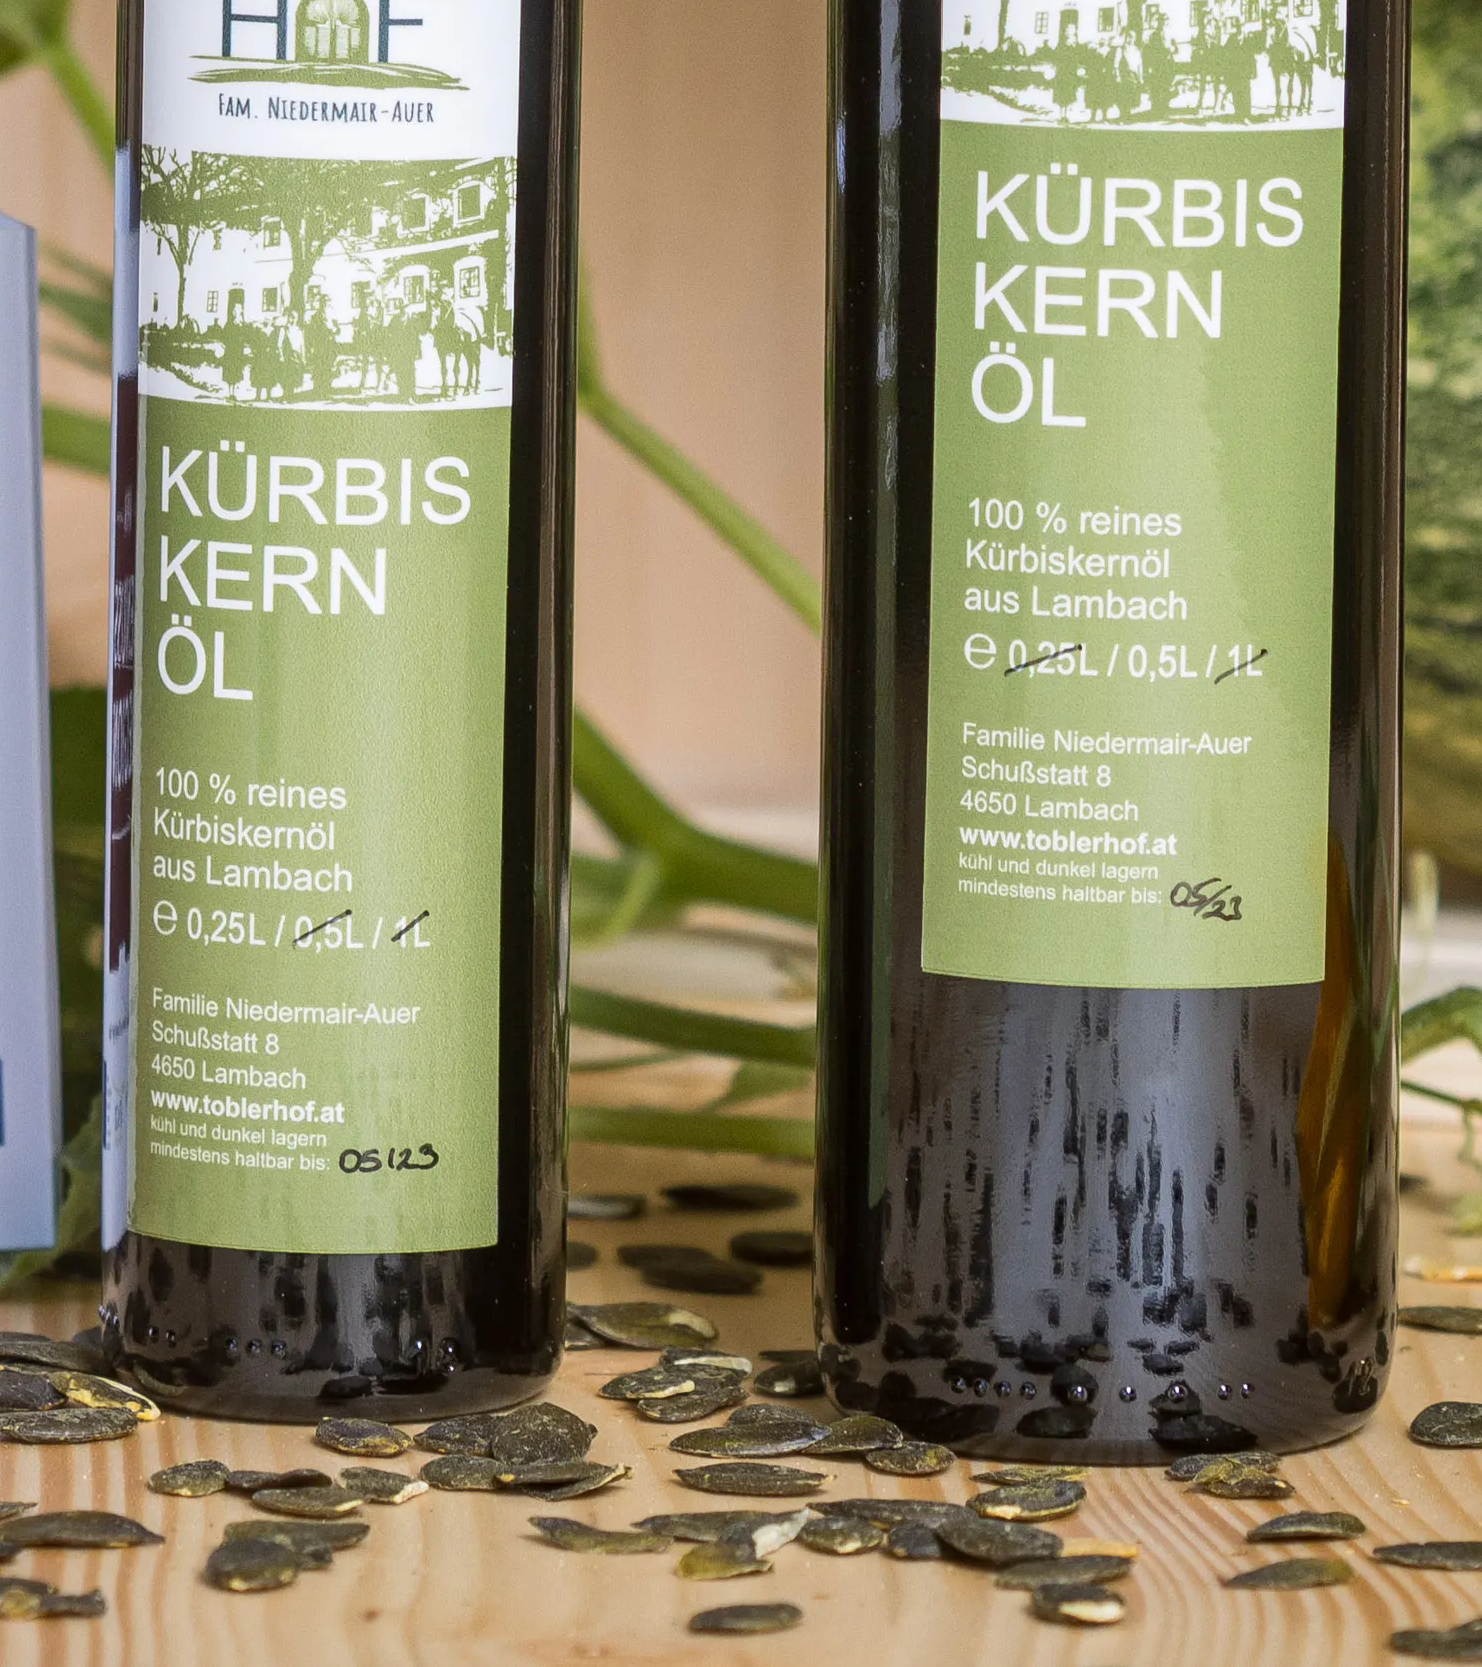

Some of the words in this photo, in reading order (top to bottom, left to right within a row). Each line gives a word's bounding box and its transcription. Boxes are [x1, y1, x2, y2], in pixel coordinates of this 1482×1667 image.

[976, 162, 1304, 247] KÜRBIS
[974, 261, 1222, 339] KERN
[971, 341, 1086, 428] ÖL
[161, 439, 471, 526] KÜRBIS
[968, 498, 1024, 532] 100
[1037, 503, 1067, 534] %
[1080, 507, 1182, 537] reines
[159, 535, 387, 615] KERN
[965, 539, 1170, 578] Kürbiskernöl
[964, 587, 1020, 614] aus
[1032, 587, 1187, 621] Lambach
[157, 613, 253, 700] ÖL
[1128, 645, 1197, 683] 0,5L
[962, 723, 1045, 751] Familie
[1054, 730, 1252, 755] Niedermair-Auer
[155, 767, 199, 801] 100
[209, 773, 236, 806] %
[247, 781, 347, 810] reines
[962, 757, 1088, 786] Schußstatt
[1096, 765, 1111, 787] 8
[960, 790, 1017, 815] 4650
[1025, 796, 1138, 822] Lambach
[153, 808, 335, 851] Kürbiskernöl
[959, 825, 1177, 855] www.toblerhof.at
[153, 856, 195, 883] aus
[206, 856, 352, 893] Lambach
[959, 852, 992, 870] kühl
[998, 857, 1030, 874] und
[1036, 858, 1095, 879] dunkel
[1101, 862, 1159, 883] lagern
[958, 878, 1056, 902] mindestens
[1062, 884, 1125, 904] haltbar
[1131, 888, 1162, 904] bis:
[187, 908, 265, 947] 0,25L
[152, 987, 218, 1018] Familie
[226, 997, 421, 1025] Niedermair-Auer
[152, 1020, 258, 1053] Schußstatt
[265, 1033, 279, 1054] 8
[151, 1053, 195, 1079] 4650
[202, 1061, 306, 1090] Lambach
[151, 1088, 345, 1124] www.toblerhof.at
[150, 1115, 176, 1134] kühl
[180, 1121, 207, 1139] und
[212, 1125, 266, 1145] dunkel
[271, 1128, 327, 1151] lagern
[150, 1140, 230, 1166] mindestens
[235, 1149, 293, 1170] haltbar
[300, 1153, 330, 1171] bis:
